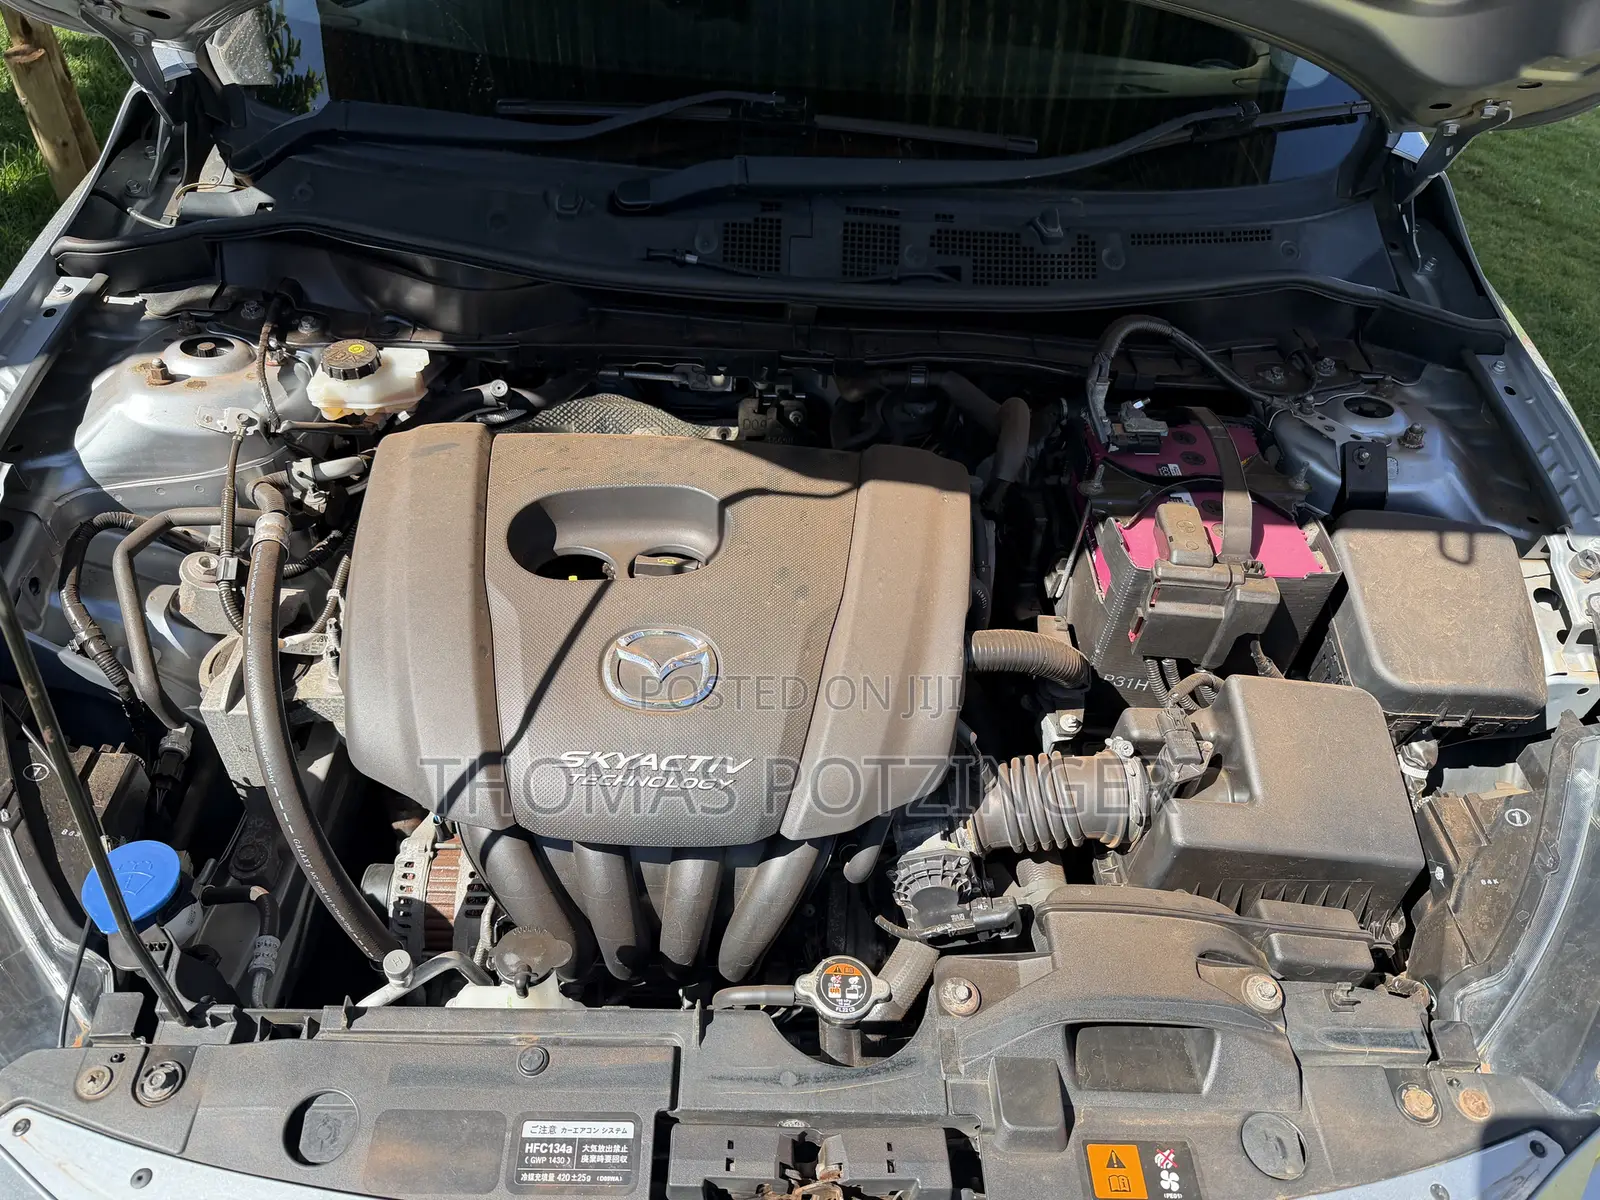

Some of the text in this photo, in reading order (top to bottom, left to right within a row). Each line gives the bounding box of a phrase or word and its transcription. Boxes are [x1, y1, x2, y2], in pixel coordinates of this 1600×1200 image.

[553, 750, 754, 775] SKYACTIV
[569, 773, 736, 791] TECHNOLOGY
[293, 838, 313, 869] GALAXY
[530, 1125, 557, 1135] ご注意
[560, 1127, 599, 1135] カーエアコン
[525, 1142, 573, 1154] HFC134a
[581, 1144, 629, 1154] 大気放出禁止
